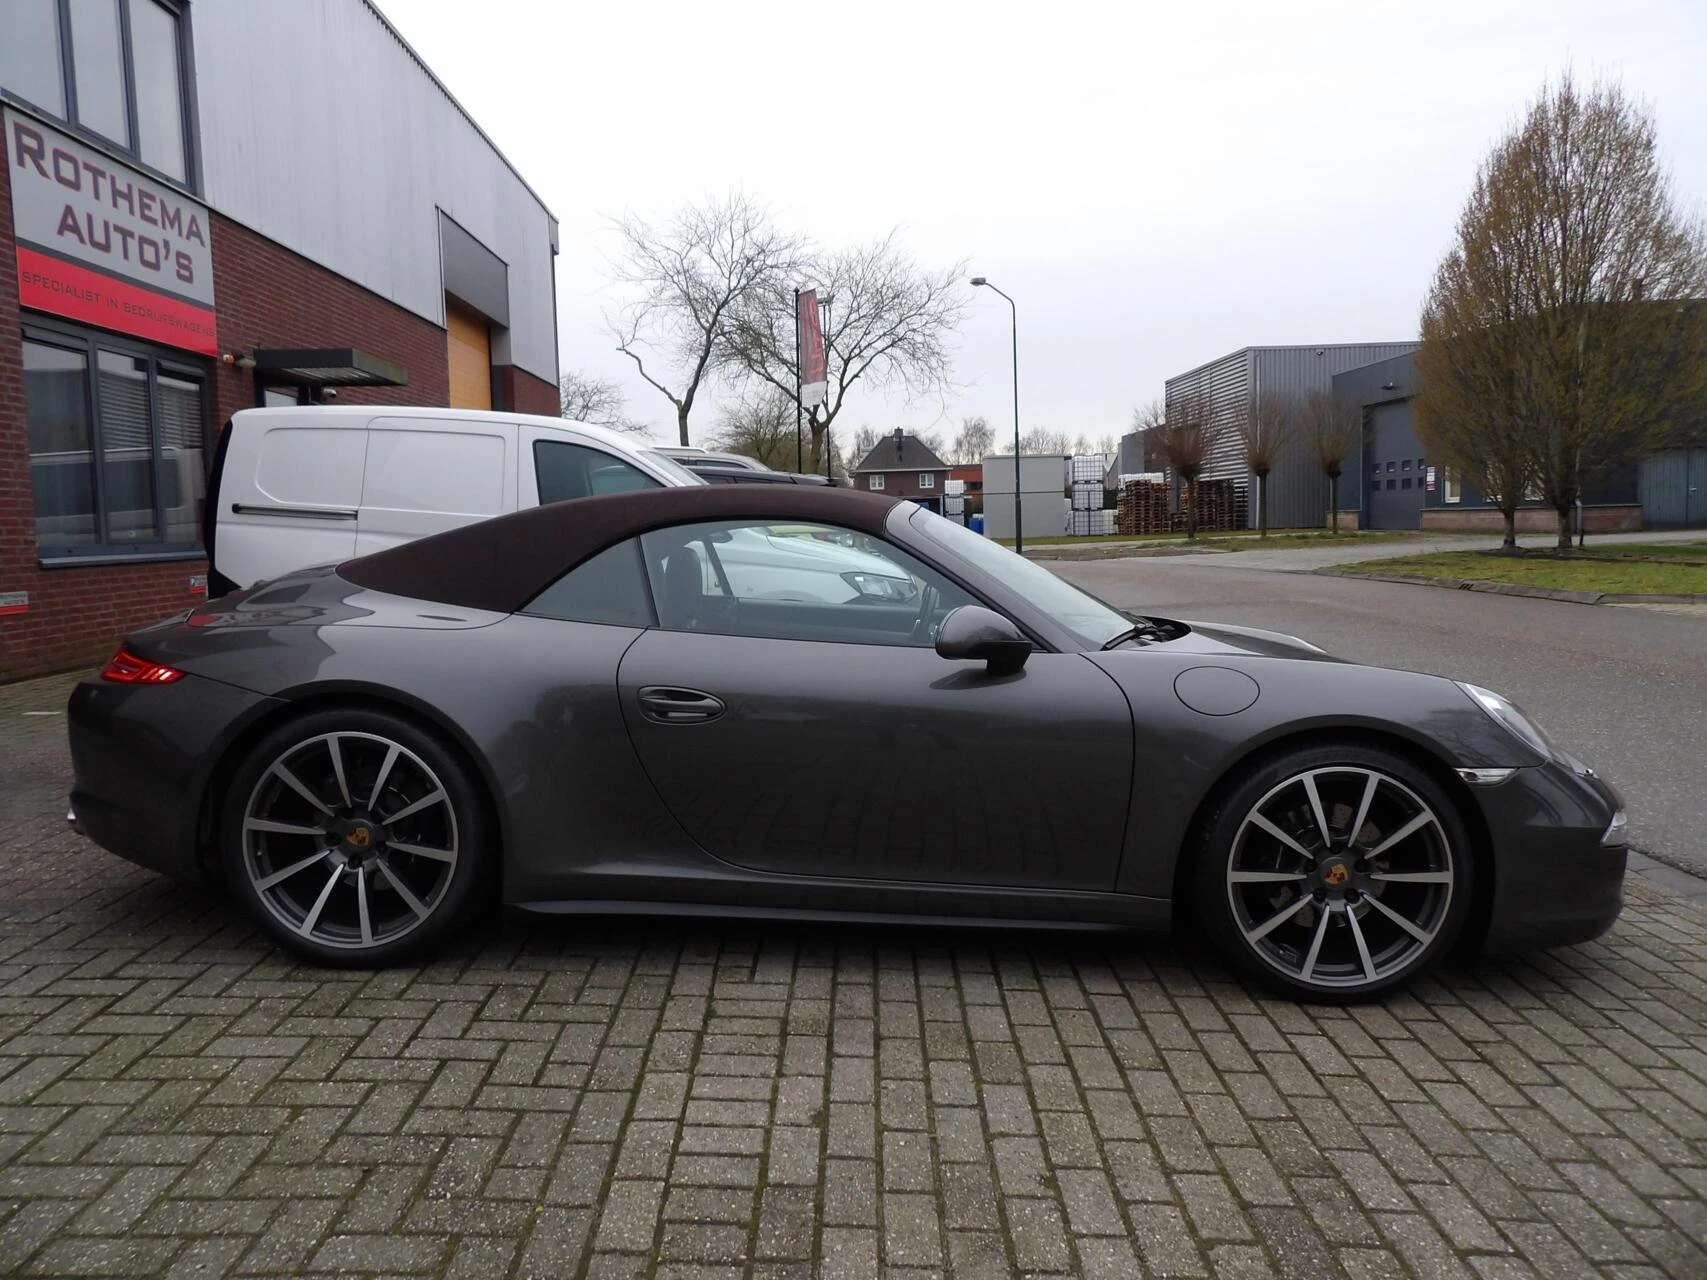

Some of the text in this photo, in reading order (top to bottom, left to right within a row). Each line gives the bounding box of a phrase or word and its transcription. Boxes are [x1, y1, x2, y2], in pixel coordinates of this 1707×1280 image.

[13, 120, 206, 248] ROTHEMA
[57, 204, 194, 284] AUTO'S
[22, 271, 101, 304] SPECIALIST
[106, 296, 119, 309] IN
